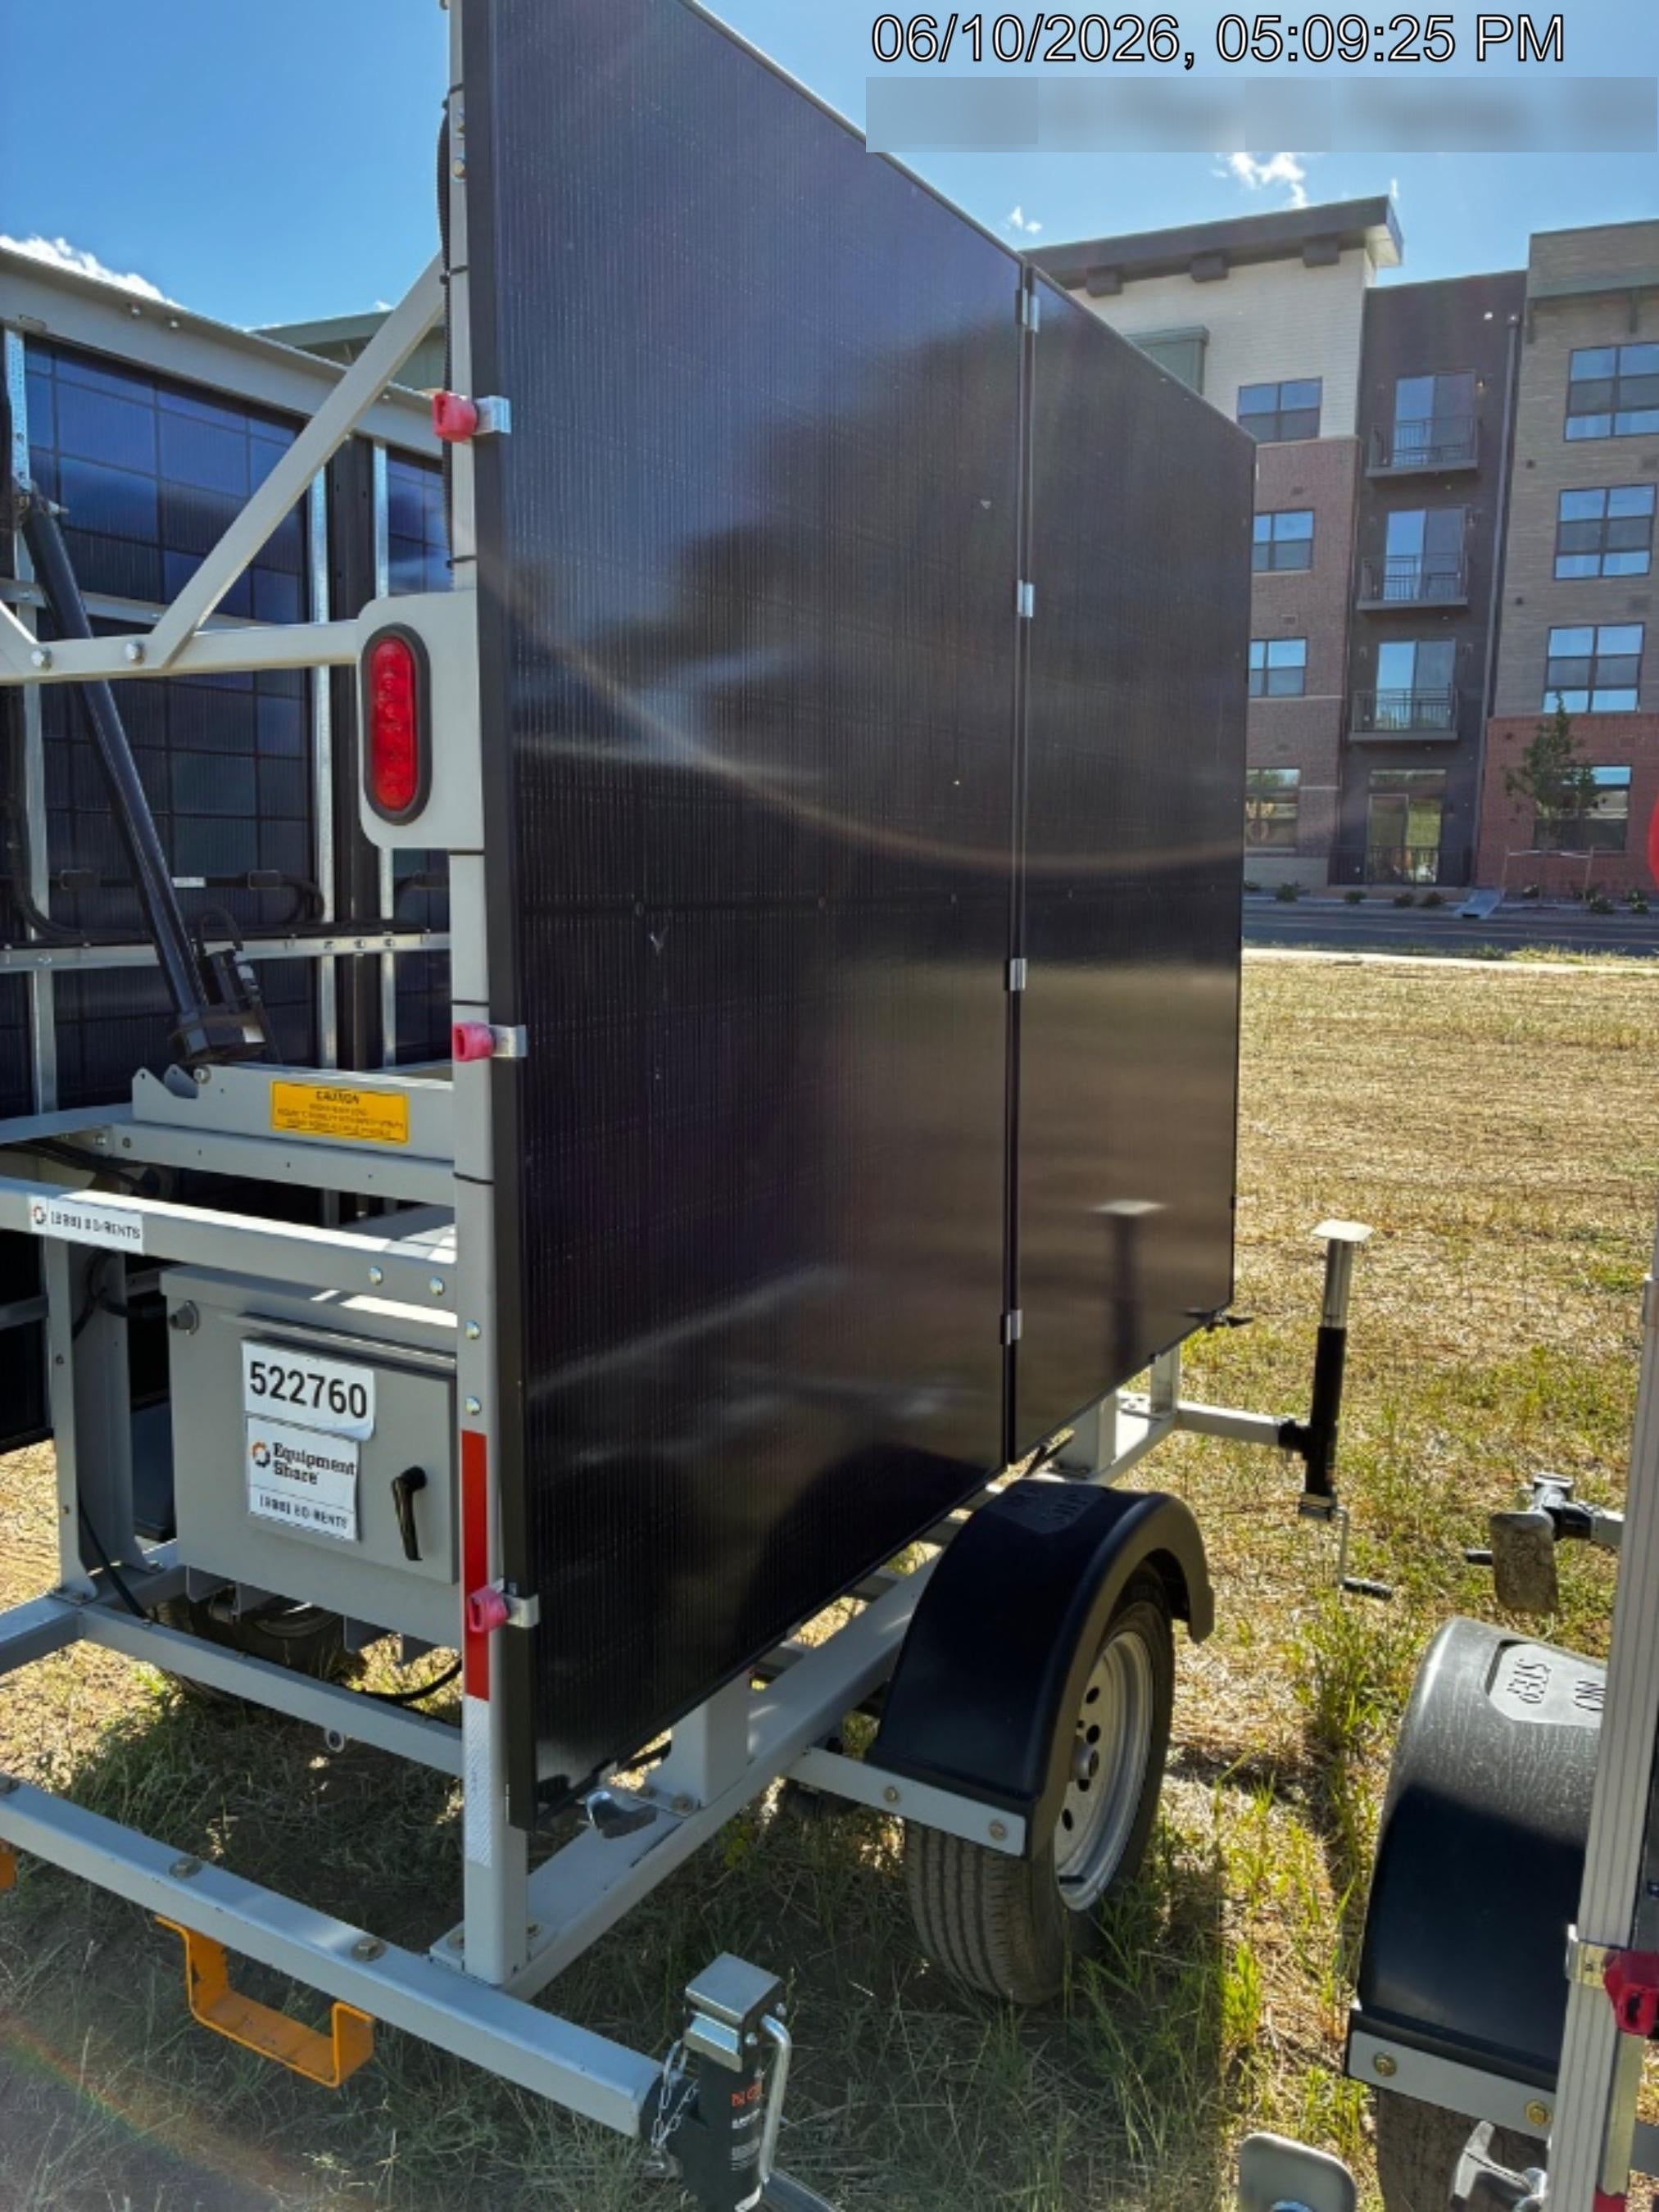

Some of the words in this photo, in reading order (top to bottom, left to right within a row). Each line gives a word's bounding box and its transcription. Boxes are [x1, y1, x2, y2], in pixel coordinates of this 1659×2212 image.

[250, 1361, 367, 1420] 522760
[273, 1442, 355, 1475] Equipment
[274, 1460, 318, 1485] Share
